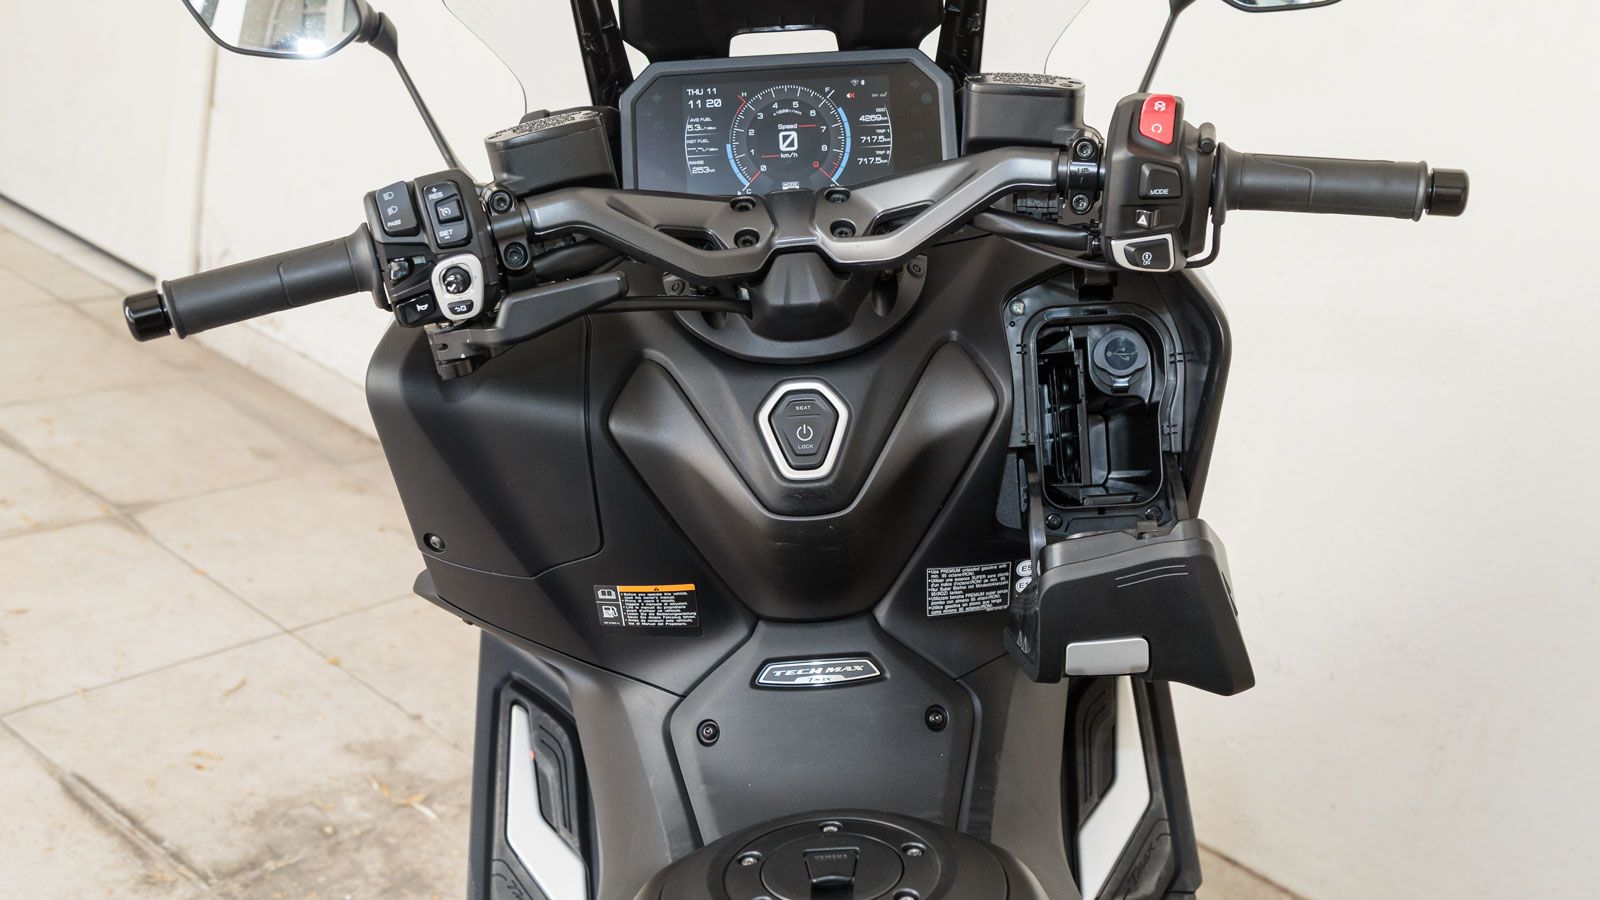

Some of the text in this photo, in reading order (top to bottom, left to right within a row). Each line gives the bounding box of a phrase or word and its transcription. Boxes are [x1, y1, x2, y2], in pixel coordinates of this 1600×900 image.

[686, 88, 704, 96] THU
[779, 131, 798, 151] 0
[428, 191, 444, 200] RES
[387, 219, 401, 228] PASS
[439, 229, 454, 237] SET
[773, 665, 864, 677] TECH MAX
